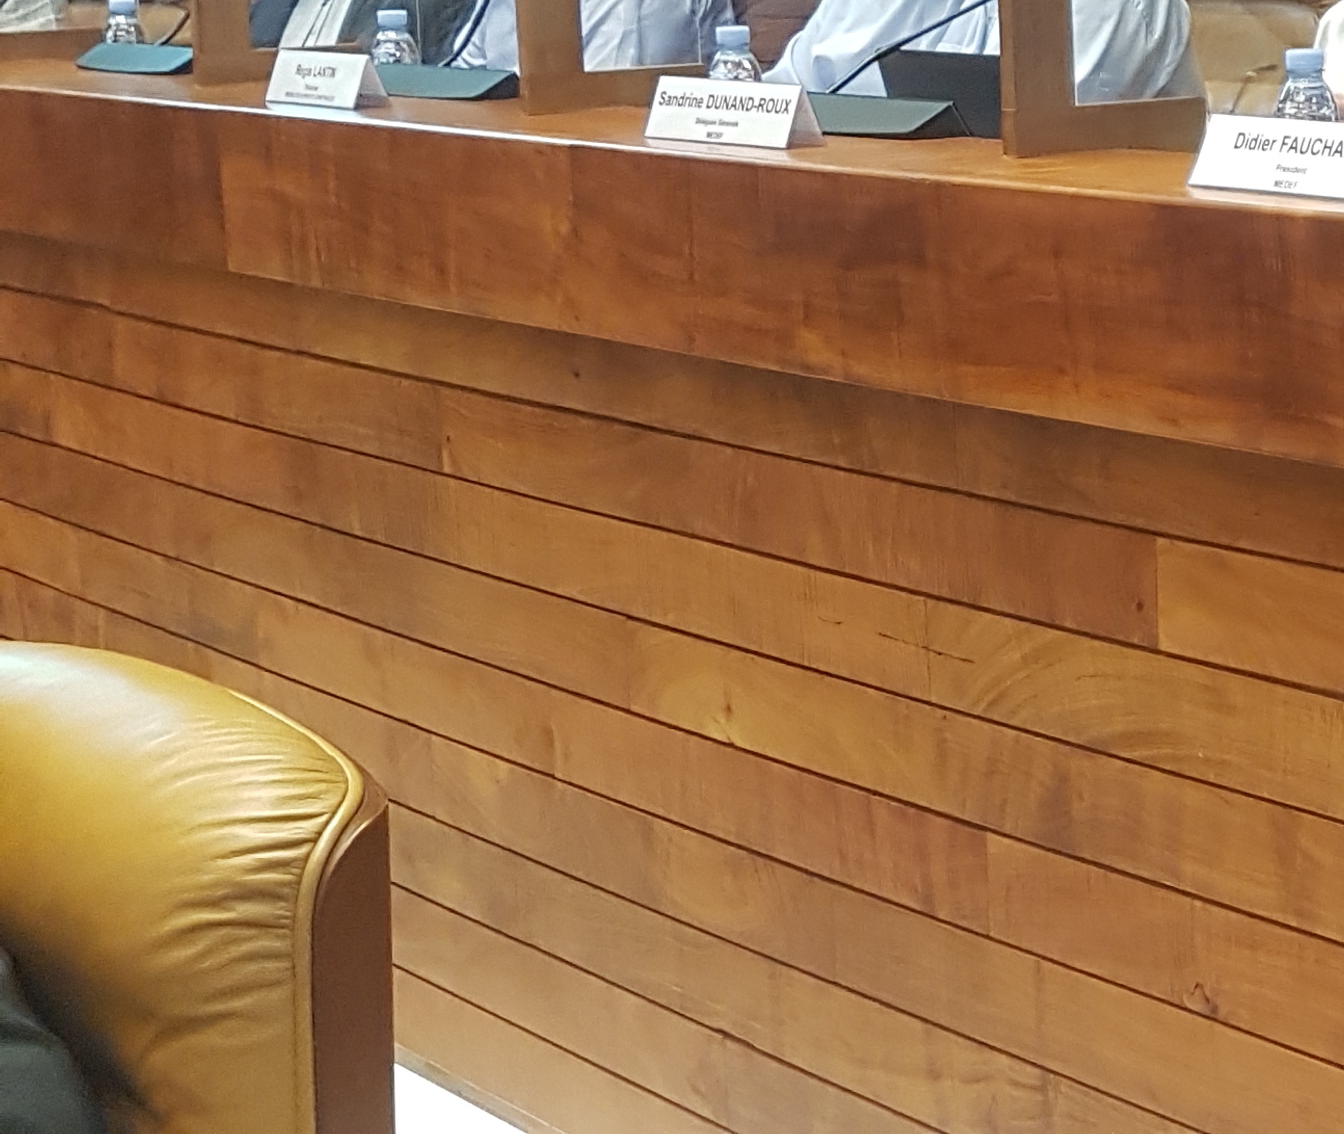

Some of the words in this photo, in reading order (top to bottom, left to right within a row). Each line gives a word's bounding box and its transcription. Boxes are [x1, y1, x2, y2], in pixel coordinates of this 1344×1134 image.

[658, 91, 704, 108] Sandrine
[705, 94, 792, 114] DUNAND-ROUX
[1233, 131, 1277, 152] Didier
